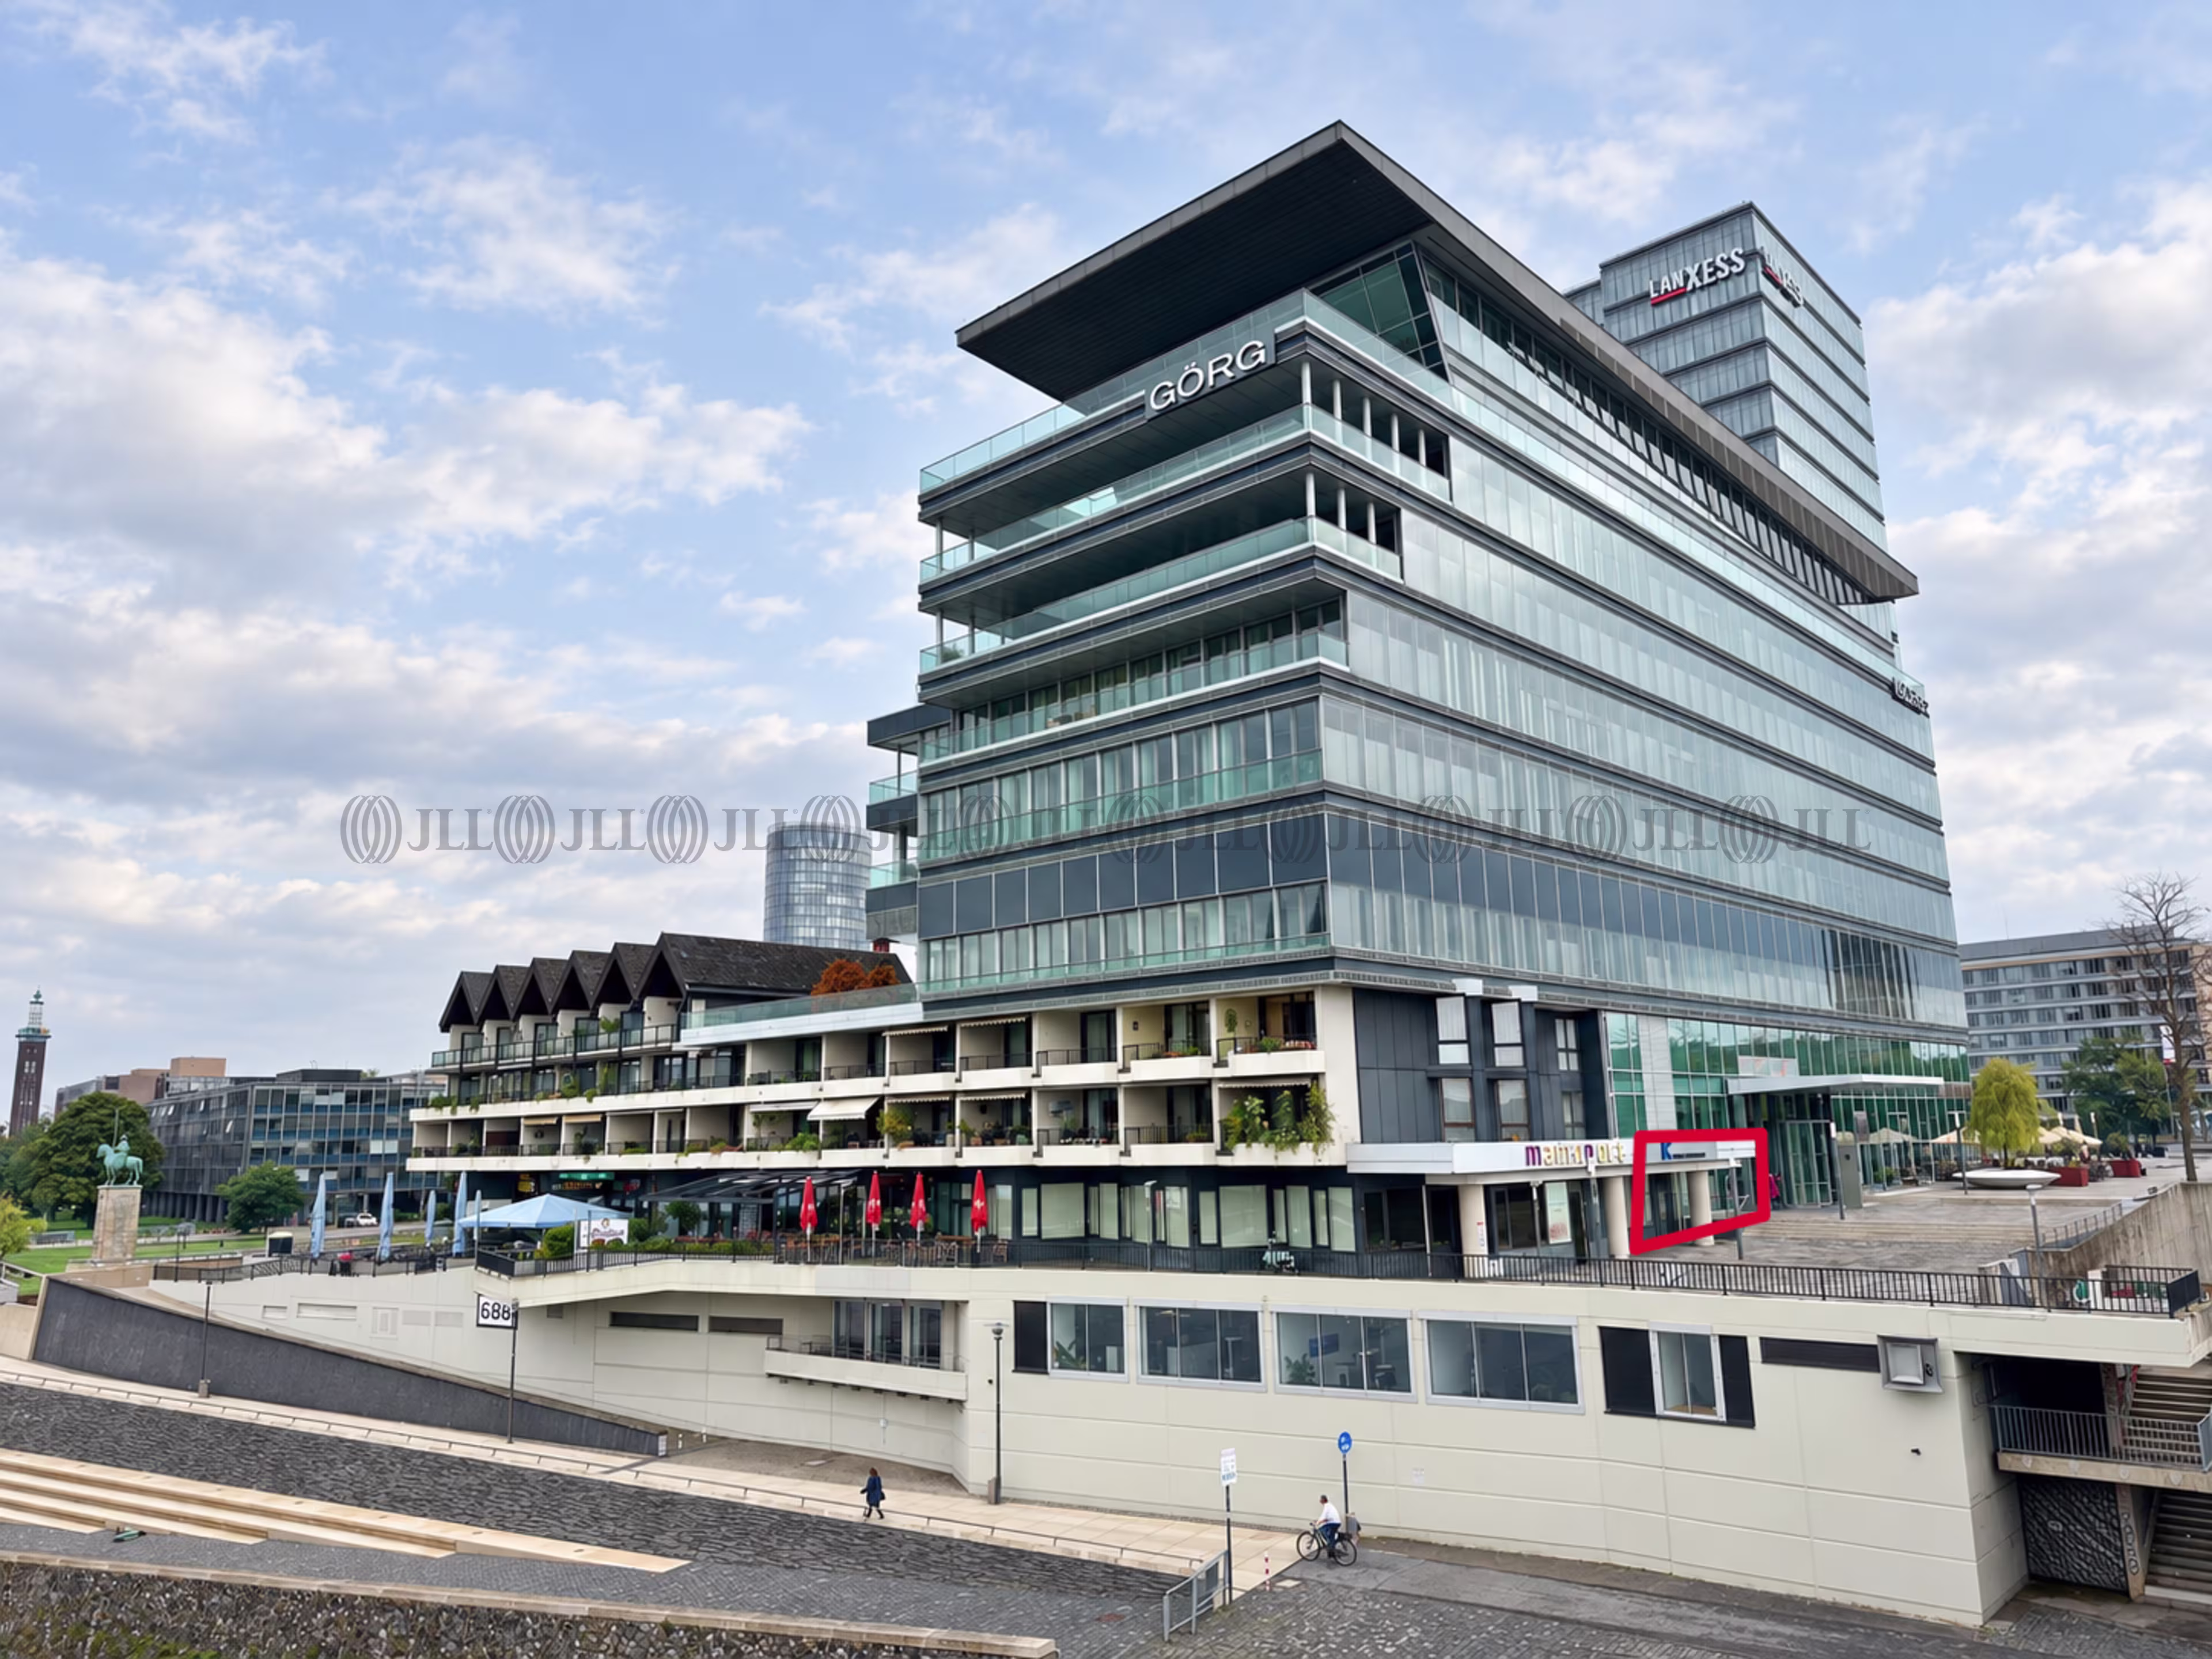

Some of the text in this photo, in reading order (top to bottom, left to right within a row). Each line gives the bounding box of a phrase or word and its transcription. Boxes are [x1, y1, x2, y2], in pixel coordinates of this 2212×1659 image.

[1649, 247, 1745, 298] LANXESS
[1150, 340, 1266, 410] GÖRG
[481, 1301, 511, 1321] 688
